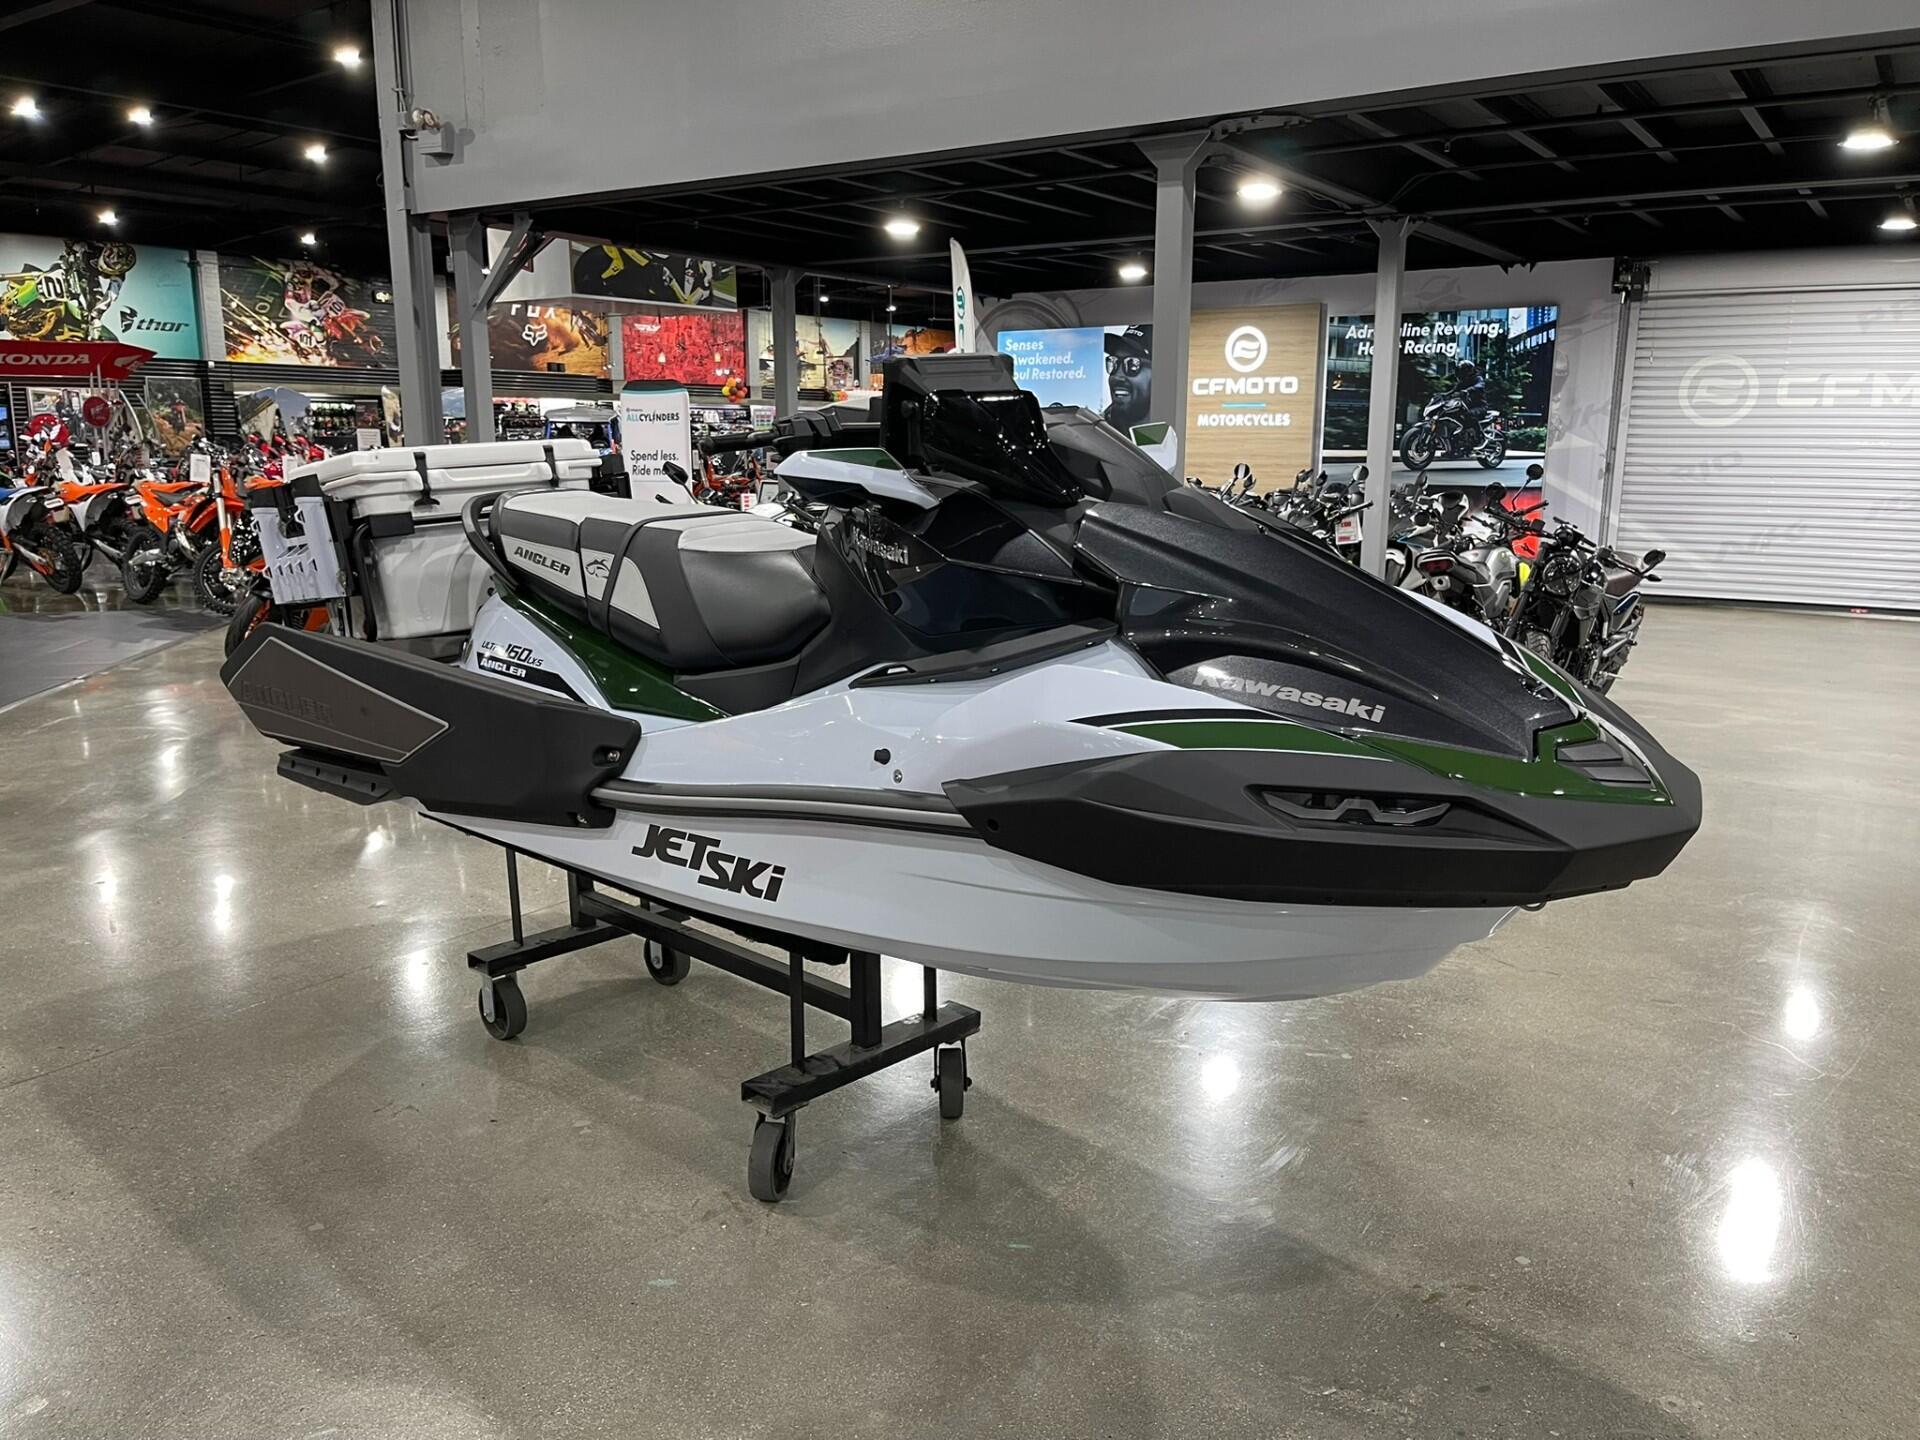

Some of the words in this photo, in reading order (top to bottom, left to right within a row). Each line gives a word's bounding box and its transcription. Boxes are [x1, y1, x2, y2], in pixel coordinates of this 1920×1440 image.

[136, 316, 191, 334] thor
[1434, 320, 1504, 338] Revving.
[1005, 338, 1044, 351] Senses
[1404, 339, 1460, 357] Racing.
[1031, 365, 1087, 380] Restored.
[1192, 376, 1299, 396] CFMOTO
[1197, 412, 1291, 427] MOTORCYCLES
[630, 449, 658, 464] Spend
[660, 449, 679, 461] less.
[632, 464, 651, 475] Ride
[514, 545, 572, 577] ANGLER
[480, 657, 527, 678] ANGLER
[1192, 664, 1386, 724] Kawasaki
